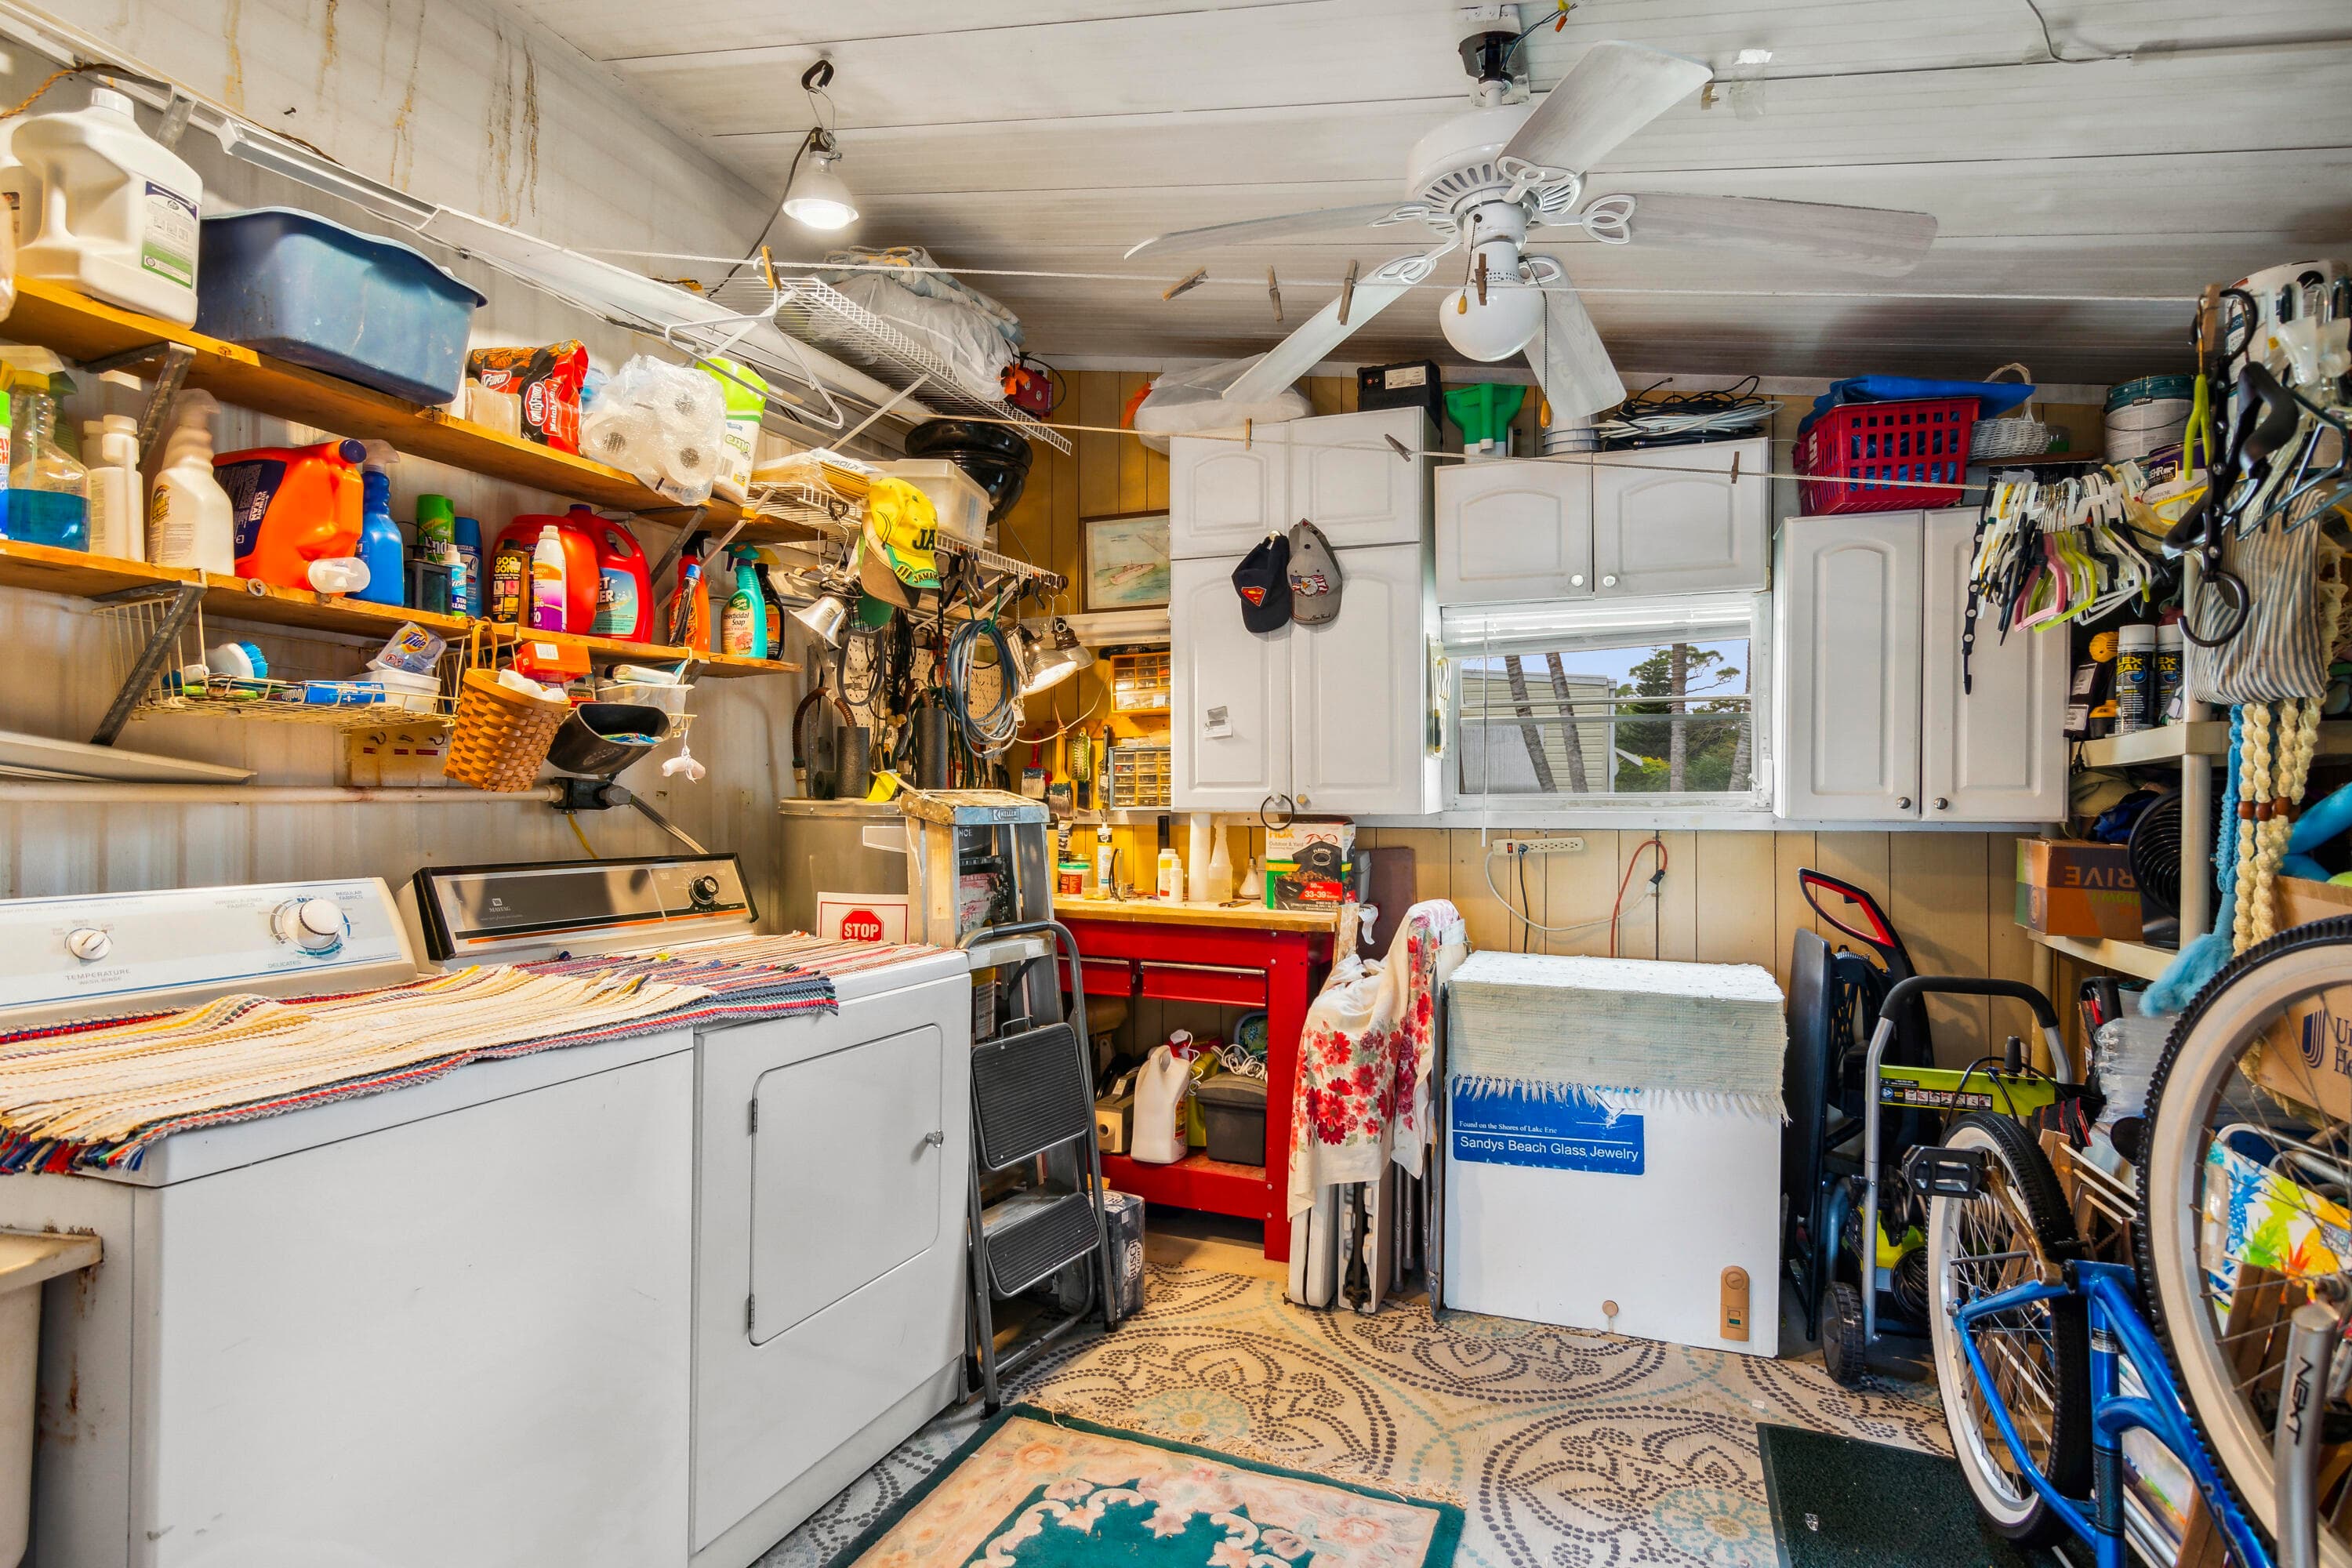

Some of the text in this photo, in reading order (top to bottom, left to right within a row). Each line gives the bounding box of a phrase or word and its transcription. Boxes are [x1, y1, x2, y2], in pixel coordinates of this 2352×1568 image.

[529, 384, 544, 423] KINGSFORD
[2149, 466, 2164, 479] EHR
[249, 492, 262, 521] CLEAN
[424, 535, 448, 555] End
[496, 556, 518, 565] GOO
[401, 631, 427, 649] Tide
[2118, 656, 2143, 665] LEX
[2118, 664, 2142, 673] EAL
[281, 688, 304, 702] Woolite
[2064, 866, 2135, 888] RIVE
[844, 923, 879, 938] STOP
[267, 960, 302, 968] DELICATES
[65, 968, 132, 981] TEMPERATURE
[1459, 1120, 1478, 1129] Found
[1460, 1137, 1504, 1154] Sandys
[1508, 1139, 1547, 1154] Beach
[1589, 1145, 1639, 1162] Jewelry
[2286, 1356, 2314, 1446] NEXT
